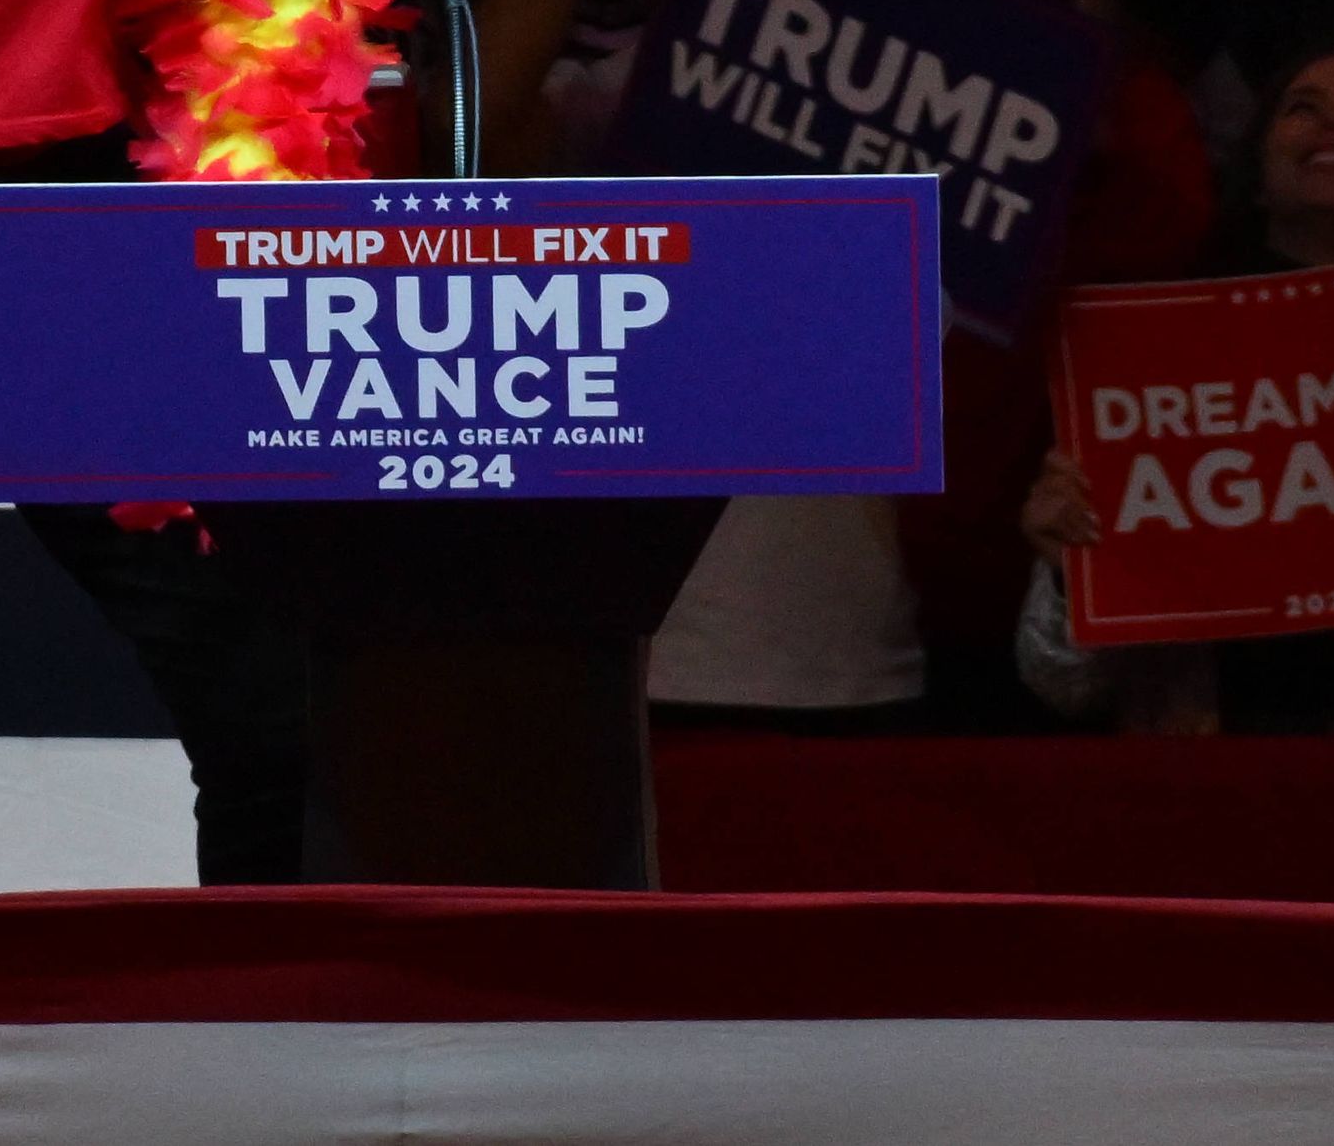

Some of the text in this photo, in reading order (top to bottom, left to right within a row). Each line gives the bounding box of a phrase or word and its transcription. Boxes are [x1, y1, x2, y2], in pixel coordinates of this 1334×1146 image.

[670, 39, 826, 161] WILL
[960, 177, 1035, 244] IT
[216, 227, 668, 265] TRUMP WILL FIX IT
[216, 274, 669, 353] TRUMP
[269, 356, 619, 420] VANCE
[248, 426, 644, 447] MAKE AMERICA GREAT AGAIN!
[378, 454, 515, 489] 2024
